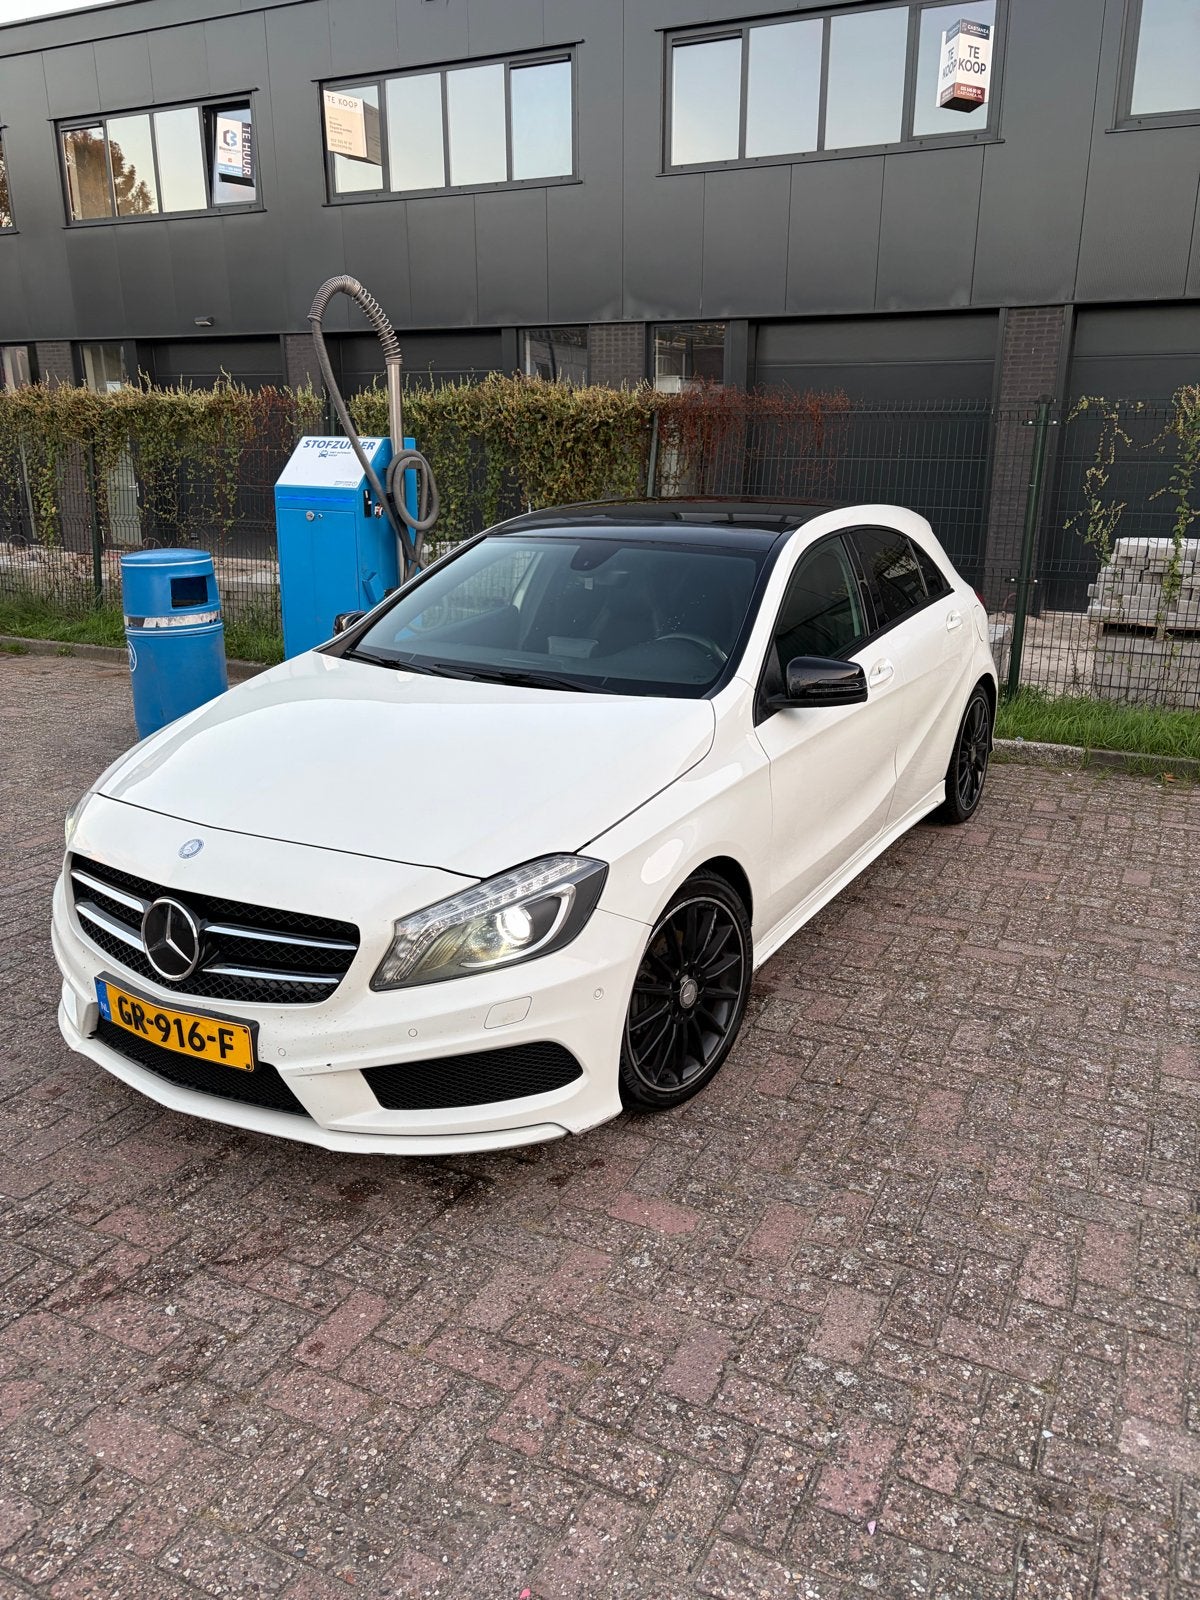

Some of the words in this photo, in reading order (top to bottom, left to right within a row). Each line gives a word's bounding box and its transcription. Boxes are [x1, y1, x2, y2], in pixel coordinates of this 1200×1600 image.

[947, 46, 955, 61] TE
[967, 44, 980, 60] TE
[958, 57, 987, 75] KOOP
[327, 95, 336, 104] TE
[338, 99, 358, 108] KOOP
[242, 126, 251, 140] TE
[242, 142, 252, 175] HUUR
[100, 1001, 109, 1013] NL
[117, 995, 234, 1059] GR-916-F
